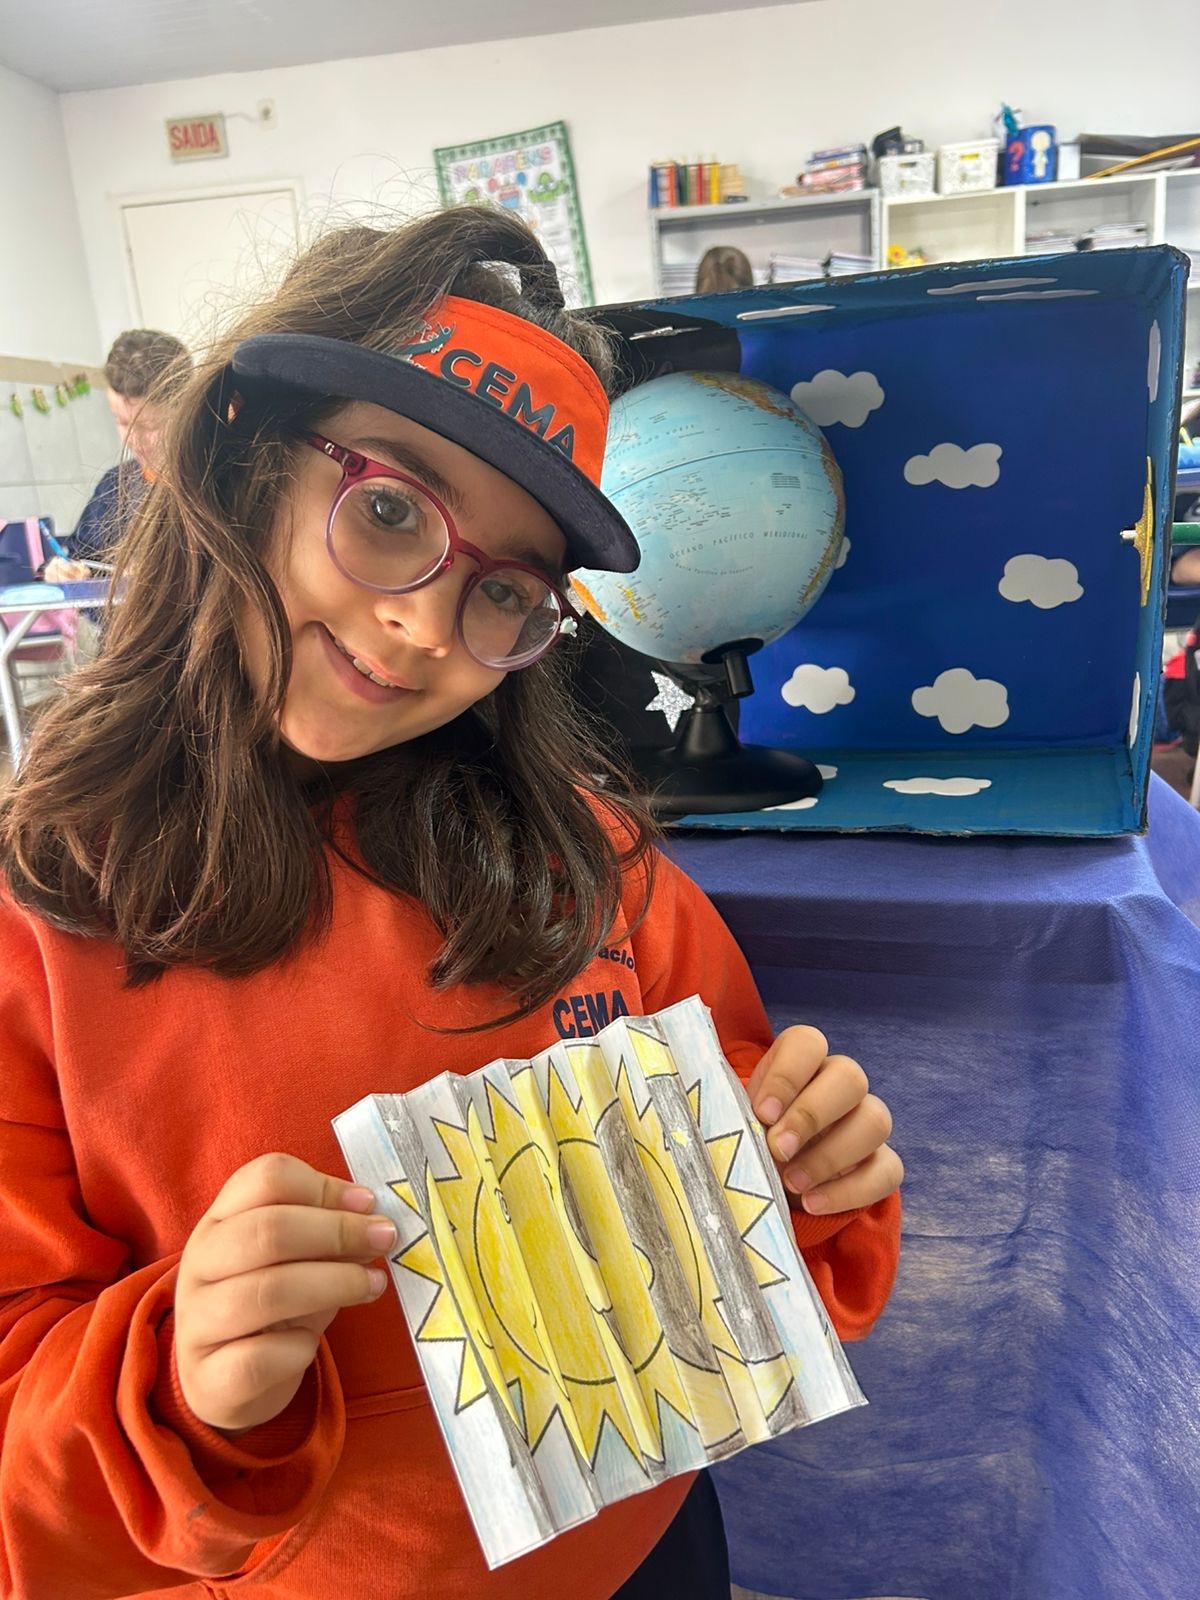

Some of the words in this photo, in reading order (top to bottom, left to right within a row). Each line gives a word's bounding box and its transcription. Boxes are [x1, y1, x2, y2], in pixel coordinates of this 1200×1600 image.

[440, 349, 575, 463] CEMA
[597, 946, 636, 971] acio
[552, 989, 630, 1040] CEMA
